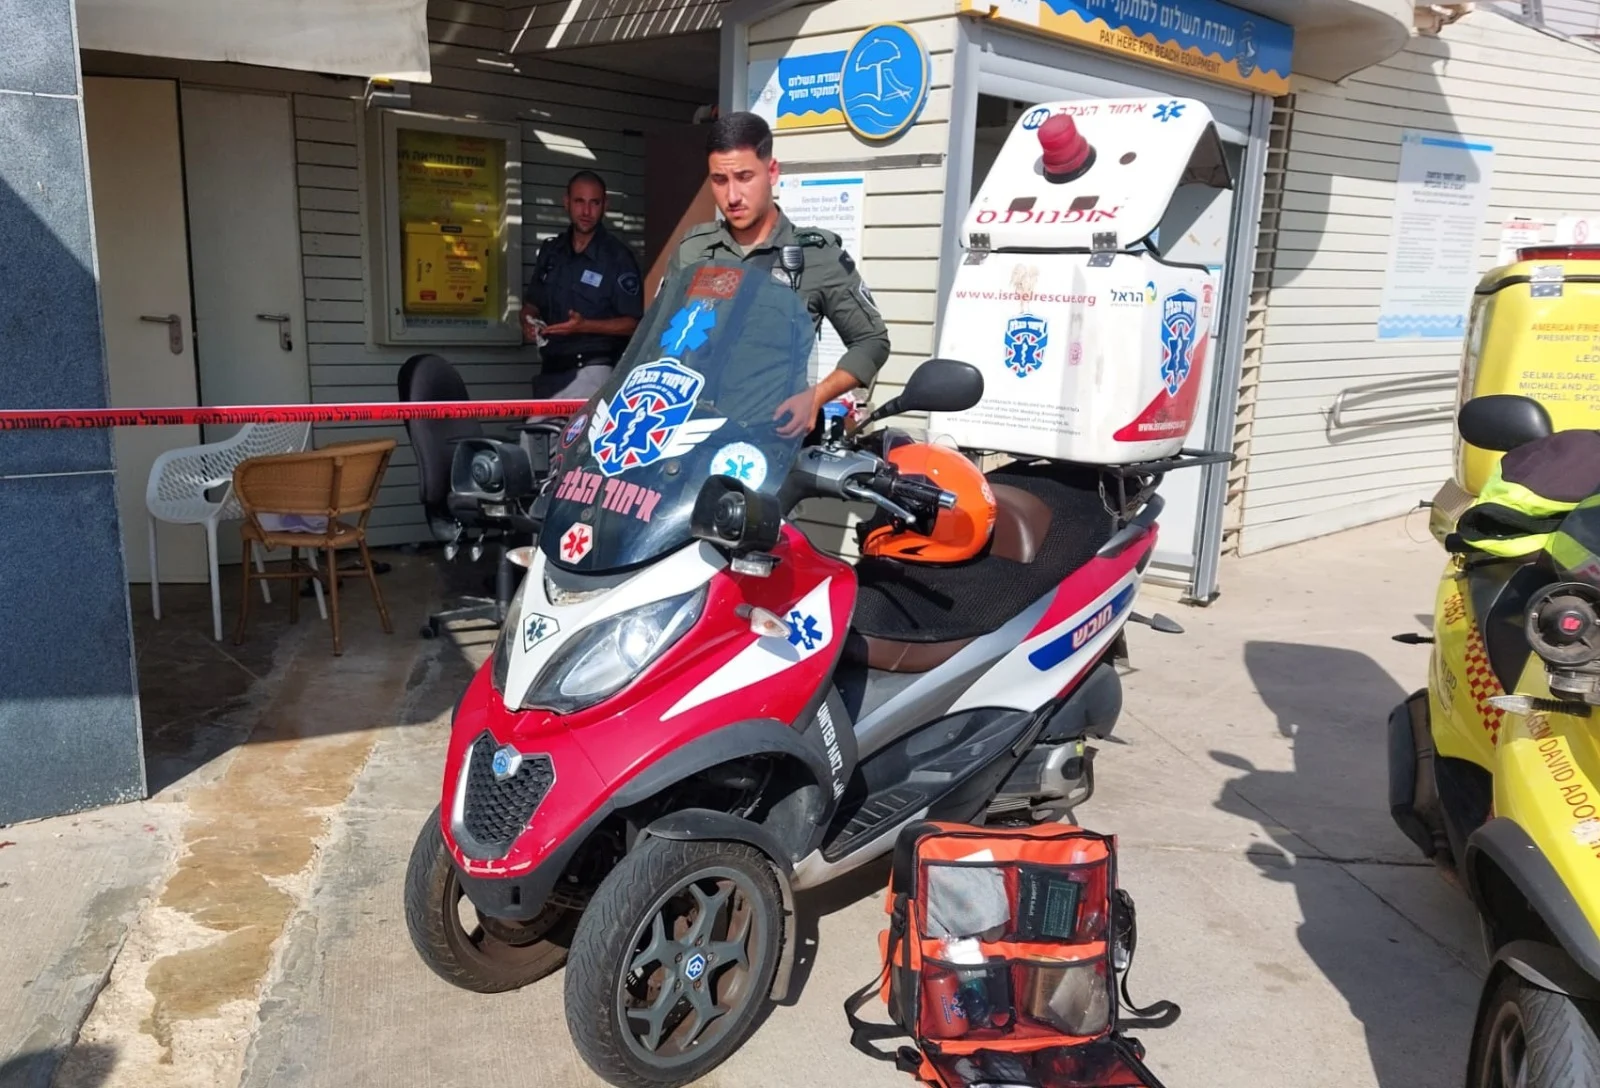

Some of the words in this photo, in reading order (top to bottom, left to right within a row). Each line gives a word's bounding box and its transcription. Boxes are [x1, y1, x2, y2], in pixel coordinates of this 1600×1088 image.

[1160, 5, 1200, 35] תשלום
[1203, 20, 1235, 47] עמדת
[1100, 29, 1114, 46] PAY
[1117, 35, 1138, 51] HERE
[1139, 40, 1153, 54] FOR
[1155, 44, 1180, 62] BEACH
[1180, 51, 1221, 74] EQUIPMENT
[788, 75, 816, 87] תשלום
[817, 72, 840, 84] עמדת
[789, 88, 809, 102] החוף
[811, 83, 840, 99] למתקני
[1108, 103, 1148, 116] איחוד
[955, 289, 1097, 306] www.israelrescue.org
[1110, 288, 1144, 303] הראל
[1537, 334, 1590, 342] PRESENTED
[1522, 371, 1554, 379] SELMA
[661, 372, 696, 398] איחוד
[1519, 382, 1560, 390] MICHAEL
[1561, 383, 1583, 391] AND
[555, 466, 603, 504] הצלה
[602, 478, 661, 523] איחוד
[1072, 604, 1112, 650] חובש
[816, 700, 836, 748] UNITED
[1539, 739, 1575, 782] DAVID
